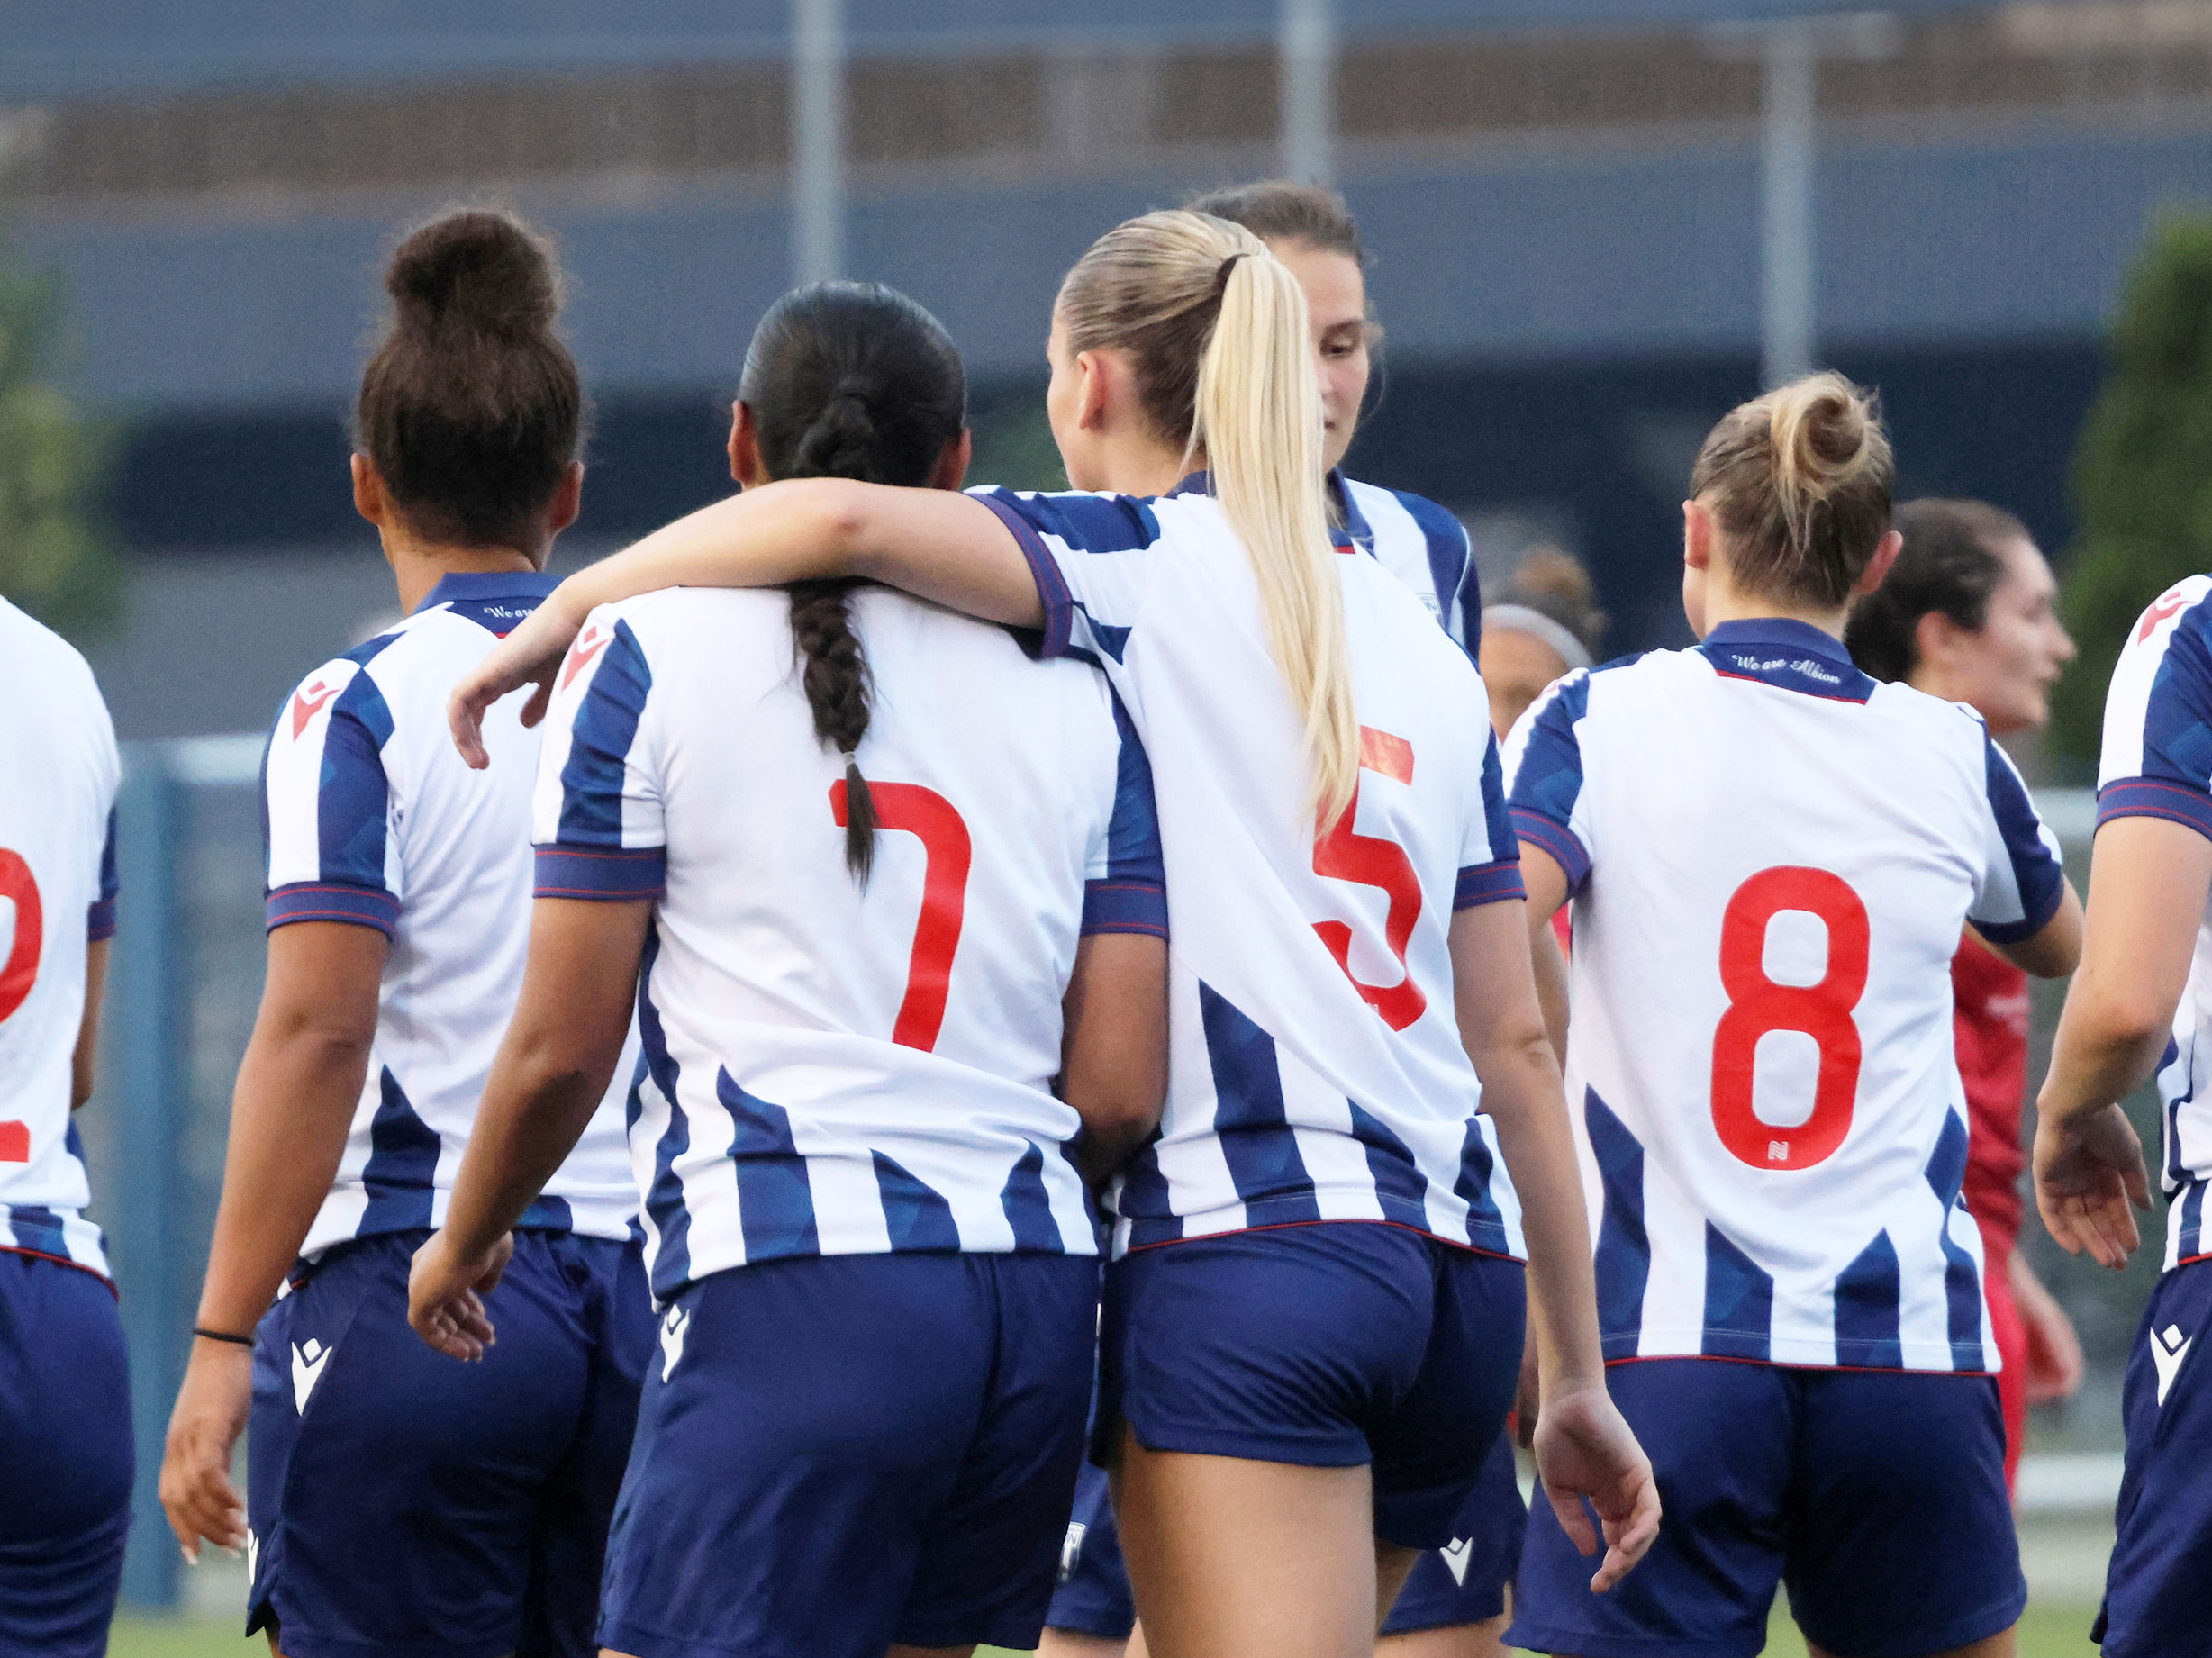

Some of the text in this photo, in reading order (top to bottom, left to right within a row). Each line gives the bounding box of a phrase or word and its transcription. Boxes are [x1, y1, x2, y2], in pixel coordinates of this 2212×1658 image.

[484, 606, 513, 618] We
[1732, 655, 1841, 684] We are Albion
[829, 779, 971, 1053] 7
[1312, 723, 1427, 1032] 5
[1710, 865, 1870, 1171] 8
